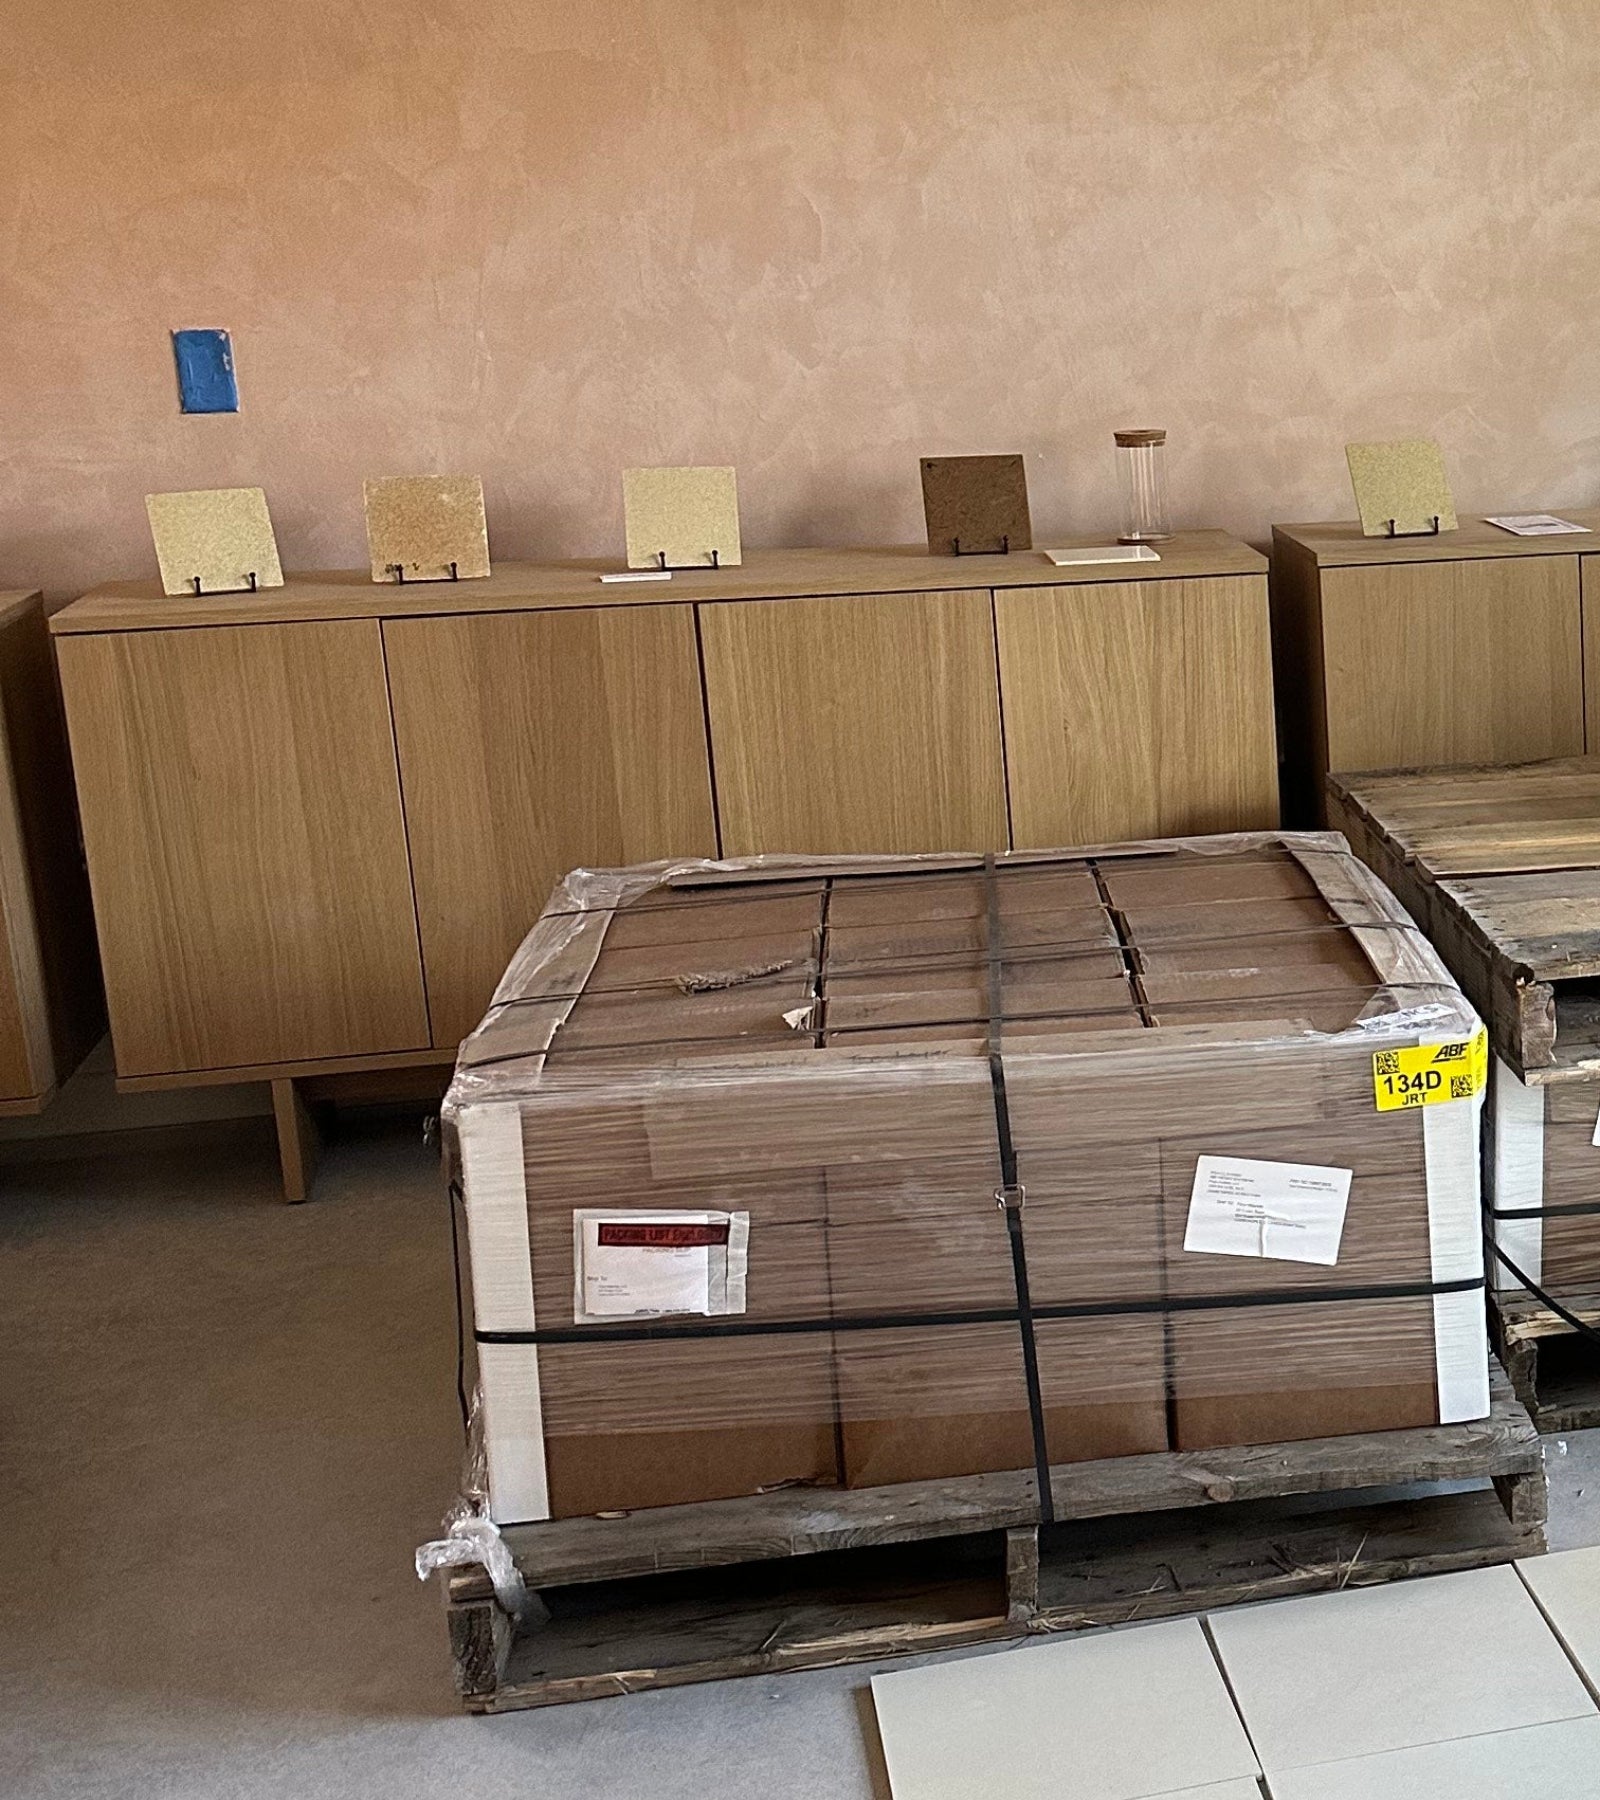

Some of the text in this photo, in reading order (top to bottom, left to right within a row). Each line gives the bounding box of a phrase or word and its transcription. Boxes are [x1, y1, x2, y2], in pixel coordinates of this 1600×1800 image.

[1435, 1042, 1470, 1059] ABF
[1383, 1070, 1442, 1095] 134D
[1402, 1092, 1428, 1105] JRT
